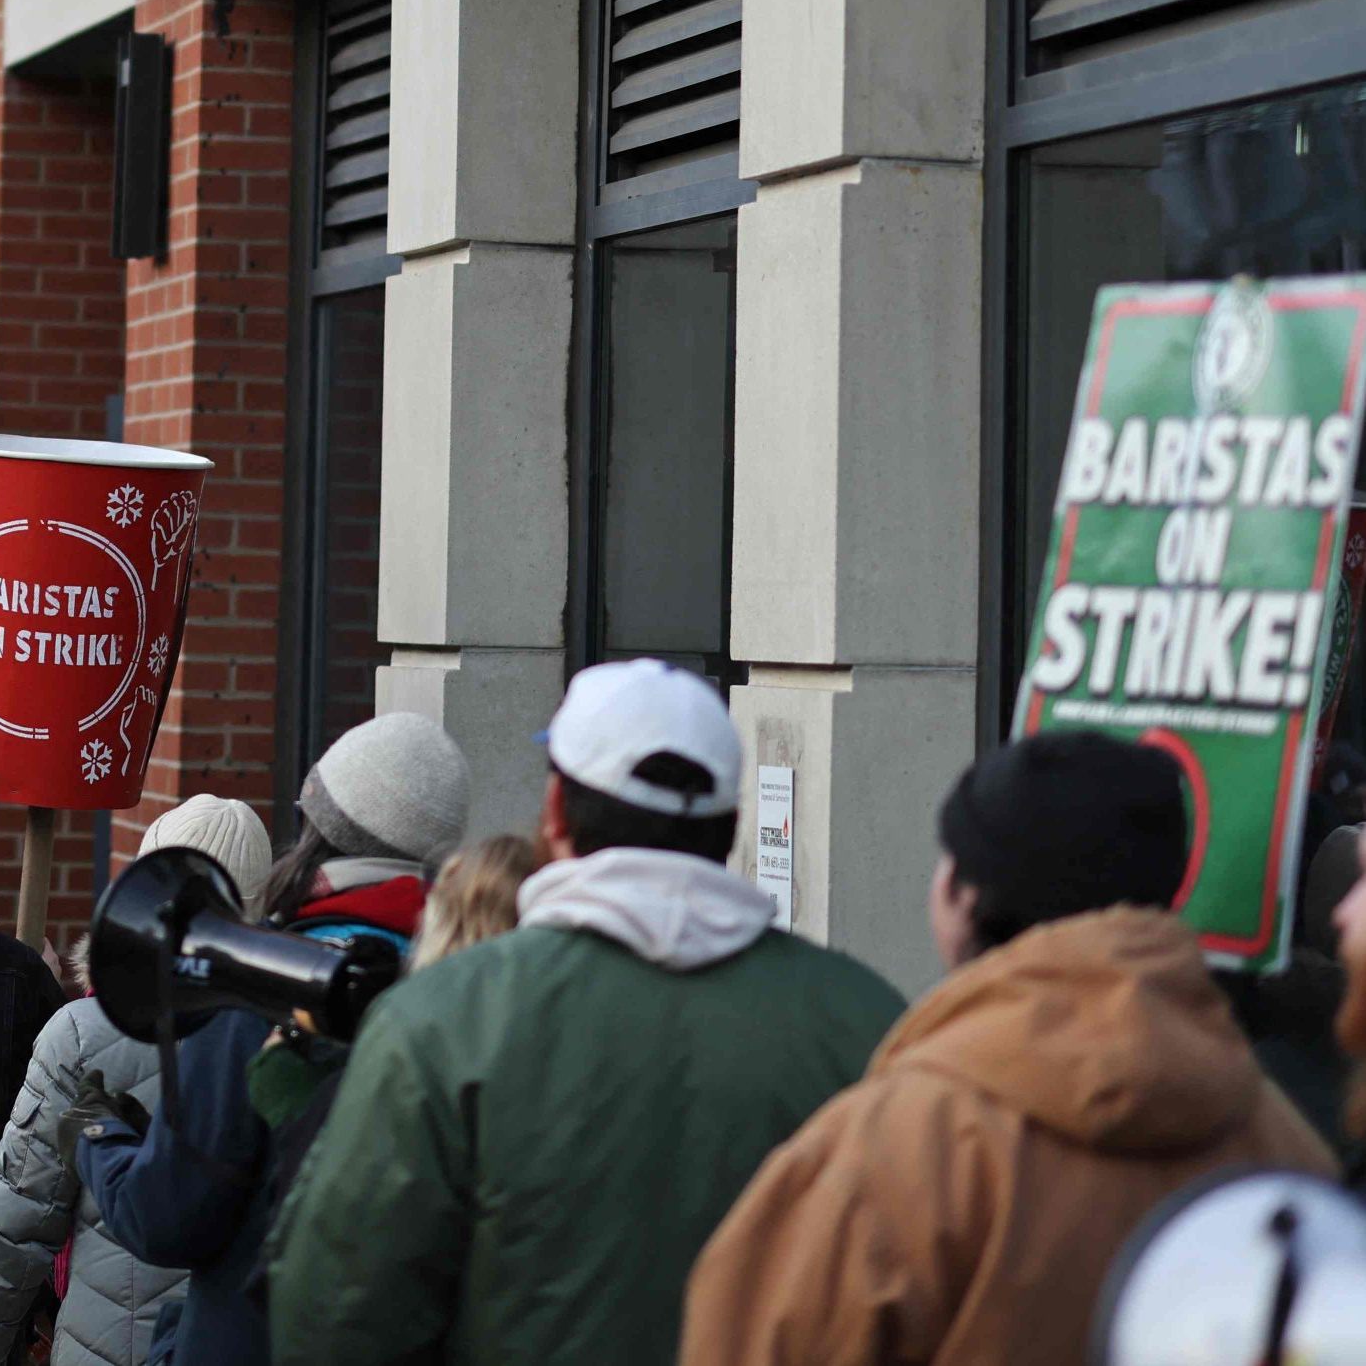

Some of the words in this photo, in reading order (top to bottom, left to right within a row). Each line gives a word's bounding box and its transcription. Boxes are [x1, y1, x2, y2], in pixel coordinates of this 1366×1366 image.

[1063, 414, 1351, 508] BARISTAS
[1156, 504, 1232, 587] ON
[14, 629, 123, 666] STRIKE
[1034, 585, 1324, 709] STRIKE!
